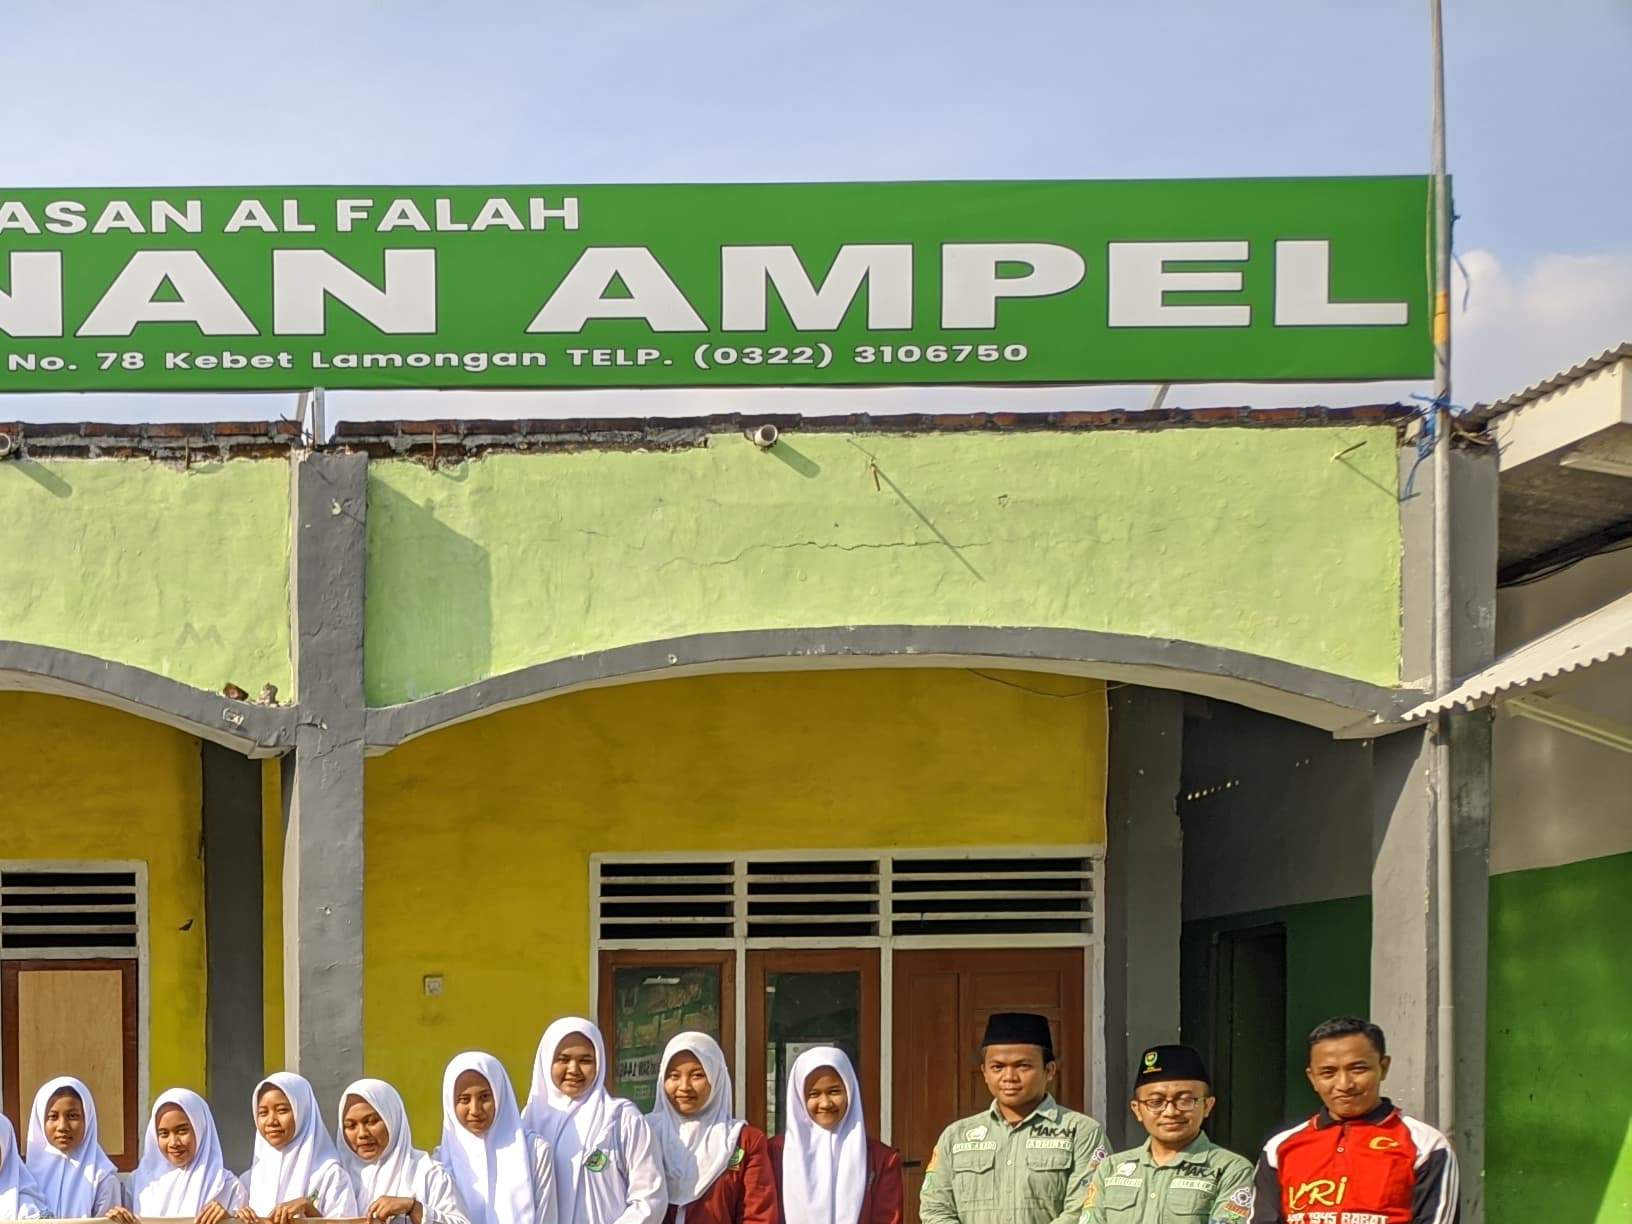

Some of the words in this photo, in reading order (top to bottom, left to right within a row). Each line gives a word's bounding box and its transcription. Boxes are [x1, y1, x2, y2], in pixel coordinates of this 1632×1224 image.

[223, 198, 316, 234] AL
[335, 197, 579, 233] FALAH
[524, 238, 1409, 334] AMPEL
[7, 352, 78, 371] No.
[96, 351, 146, 371] 78
[164, 350, 295, 370] Kebet
[312, 350, 547, 373] Lamongan
[566, 347, 674, 368] TELP.
[694, 343, 834, 370] (0322)
[853, 343, 1030, 365] 3106750
[1308, 1212, 1337, 1224] 1945
